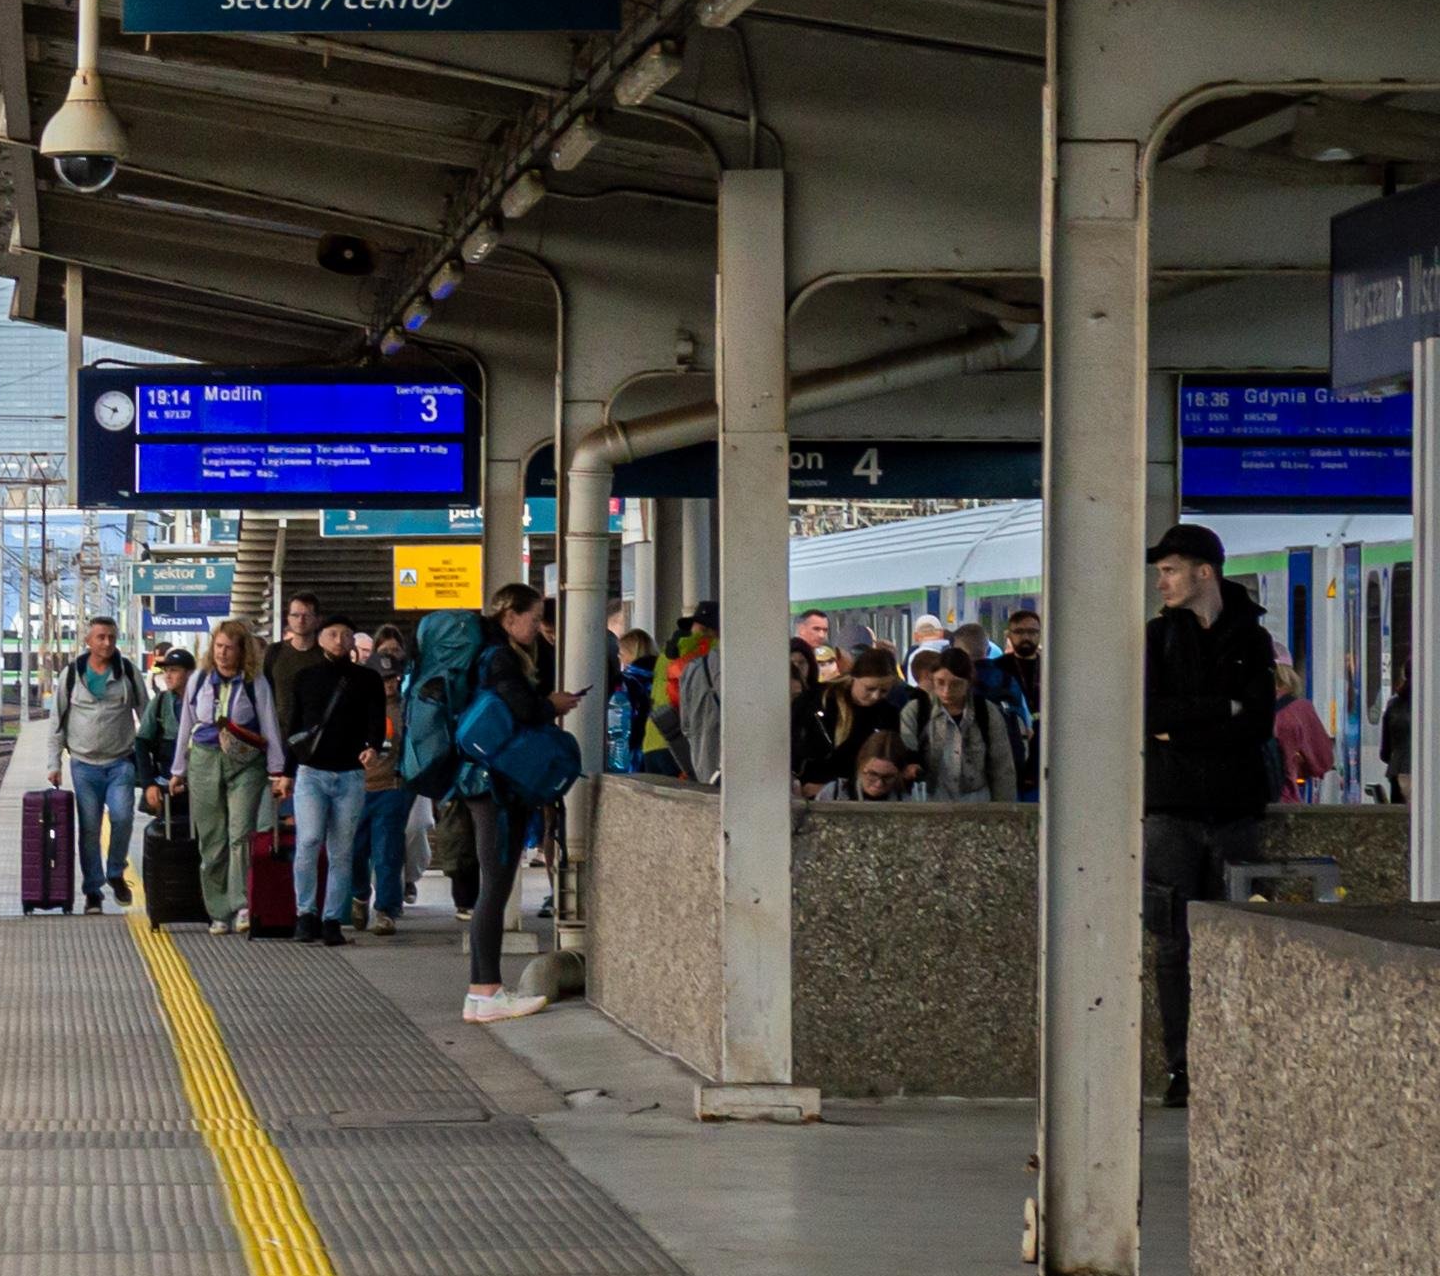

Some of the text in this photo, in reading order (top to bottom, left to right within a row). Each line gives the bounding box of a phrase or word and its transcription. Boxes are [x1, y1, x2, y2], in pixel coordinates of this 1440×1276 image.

[147, 386, 263, 406] 19:14 Modlin
[1244, 388, 1307, 407] Gdynia
[420, 395, 439, 423] 3
[852, 447, 883, 485] 4
[152, 566, 216, 580] sektor B
[151, 615, 203, 626] Warszawa
